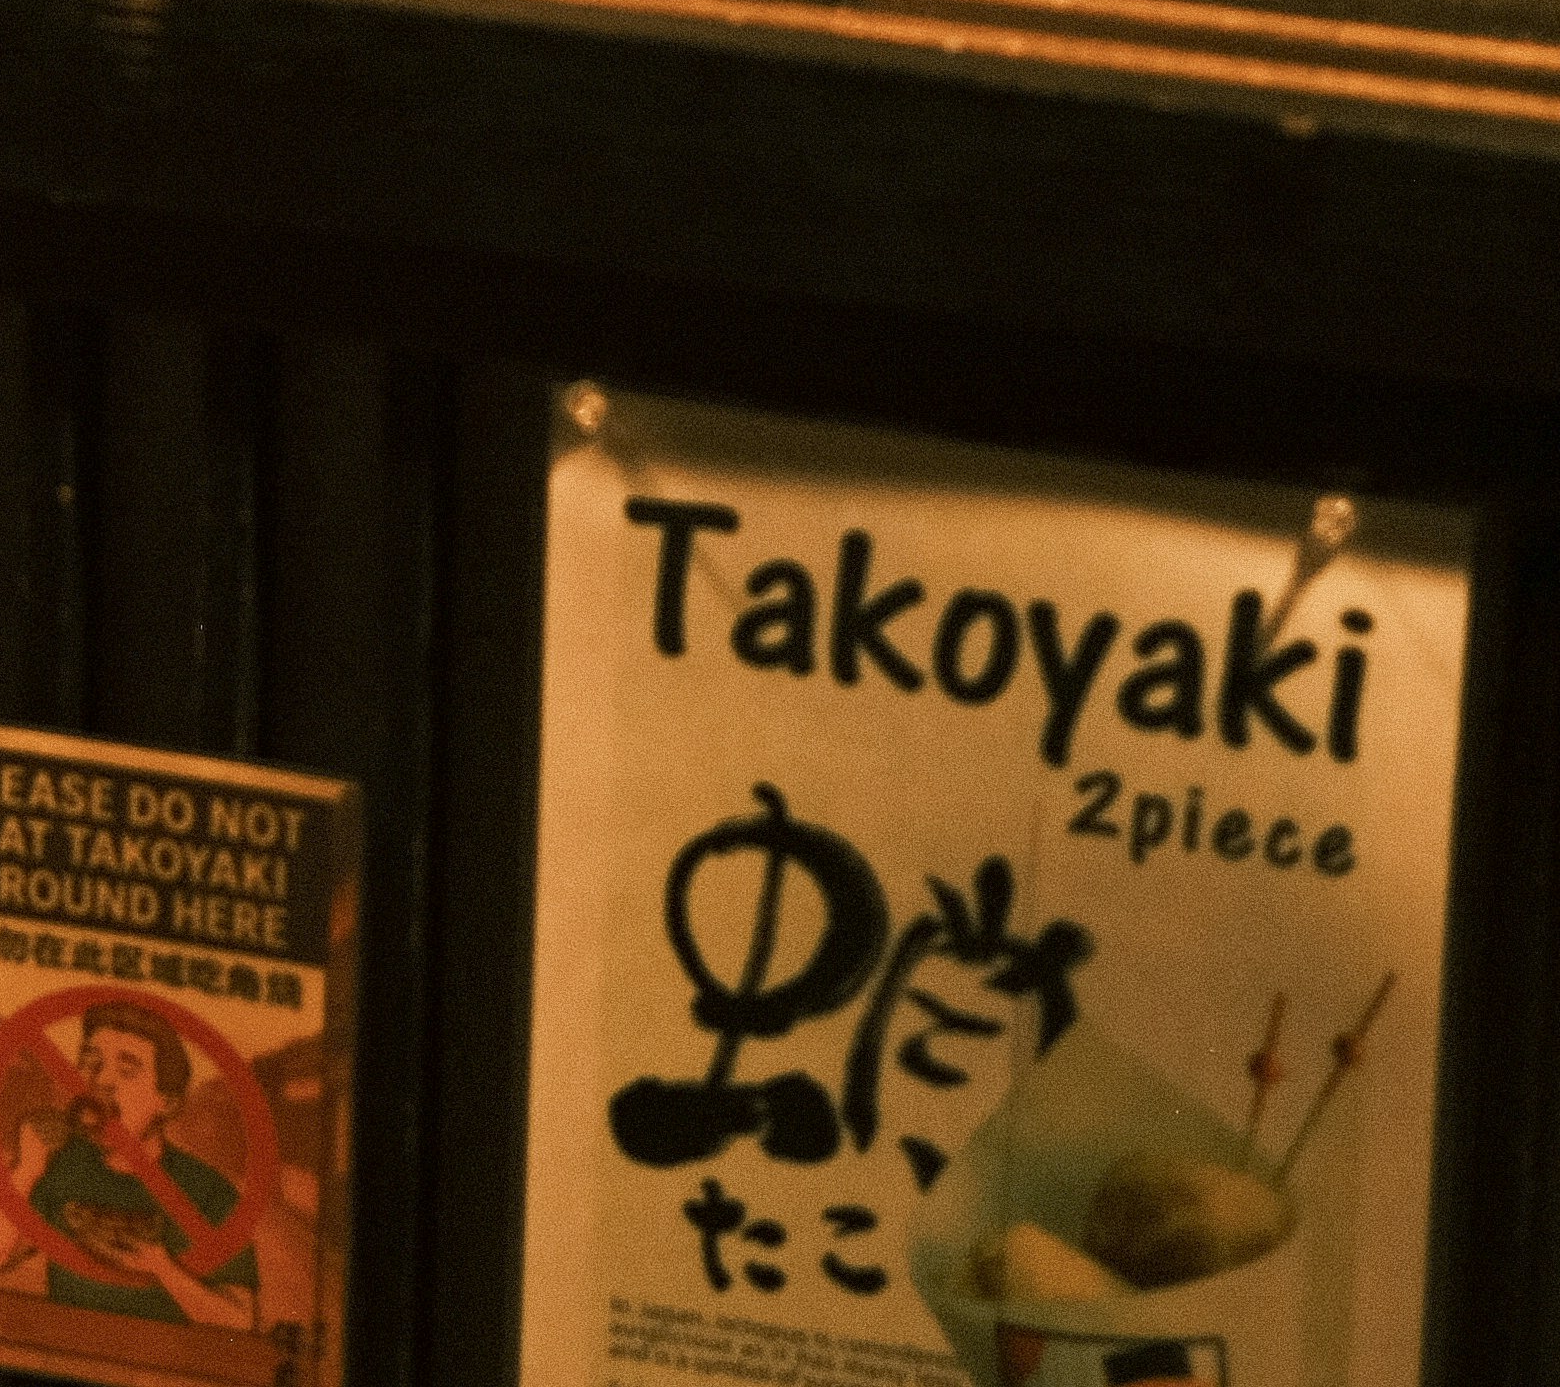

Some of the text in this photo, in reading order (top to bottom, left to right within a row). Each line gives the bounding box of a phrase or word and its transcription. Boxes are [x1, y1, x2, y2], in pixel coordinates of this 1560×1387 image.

[625, 495, 1378, 768] Takoyaki
[128, 783, 193, 832] DO
[210, 796, 303, 849] NOT
[1067, 769, 1357, 879] 2piece
[67, 826, 289, 897] TAKOYAKI
[171, 894, 289, 946] HERE
[681, 1176, 888, 1296] たこ
